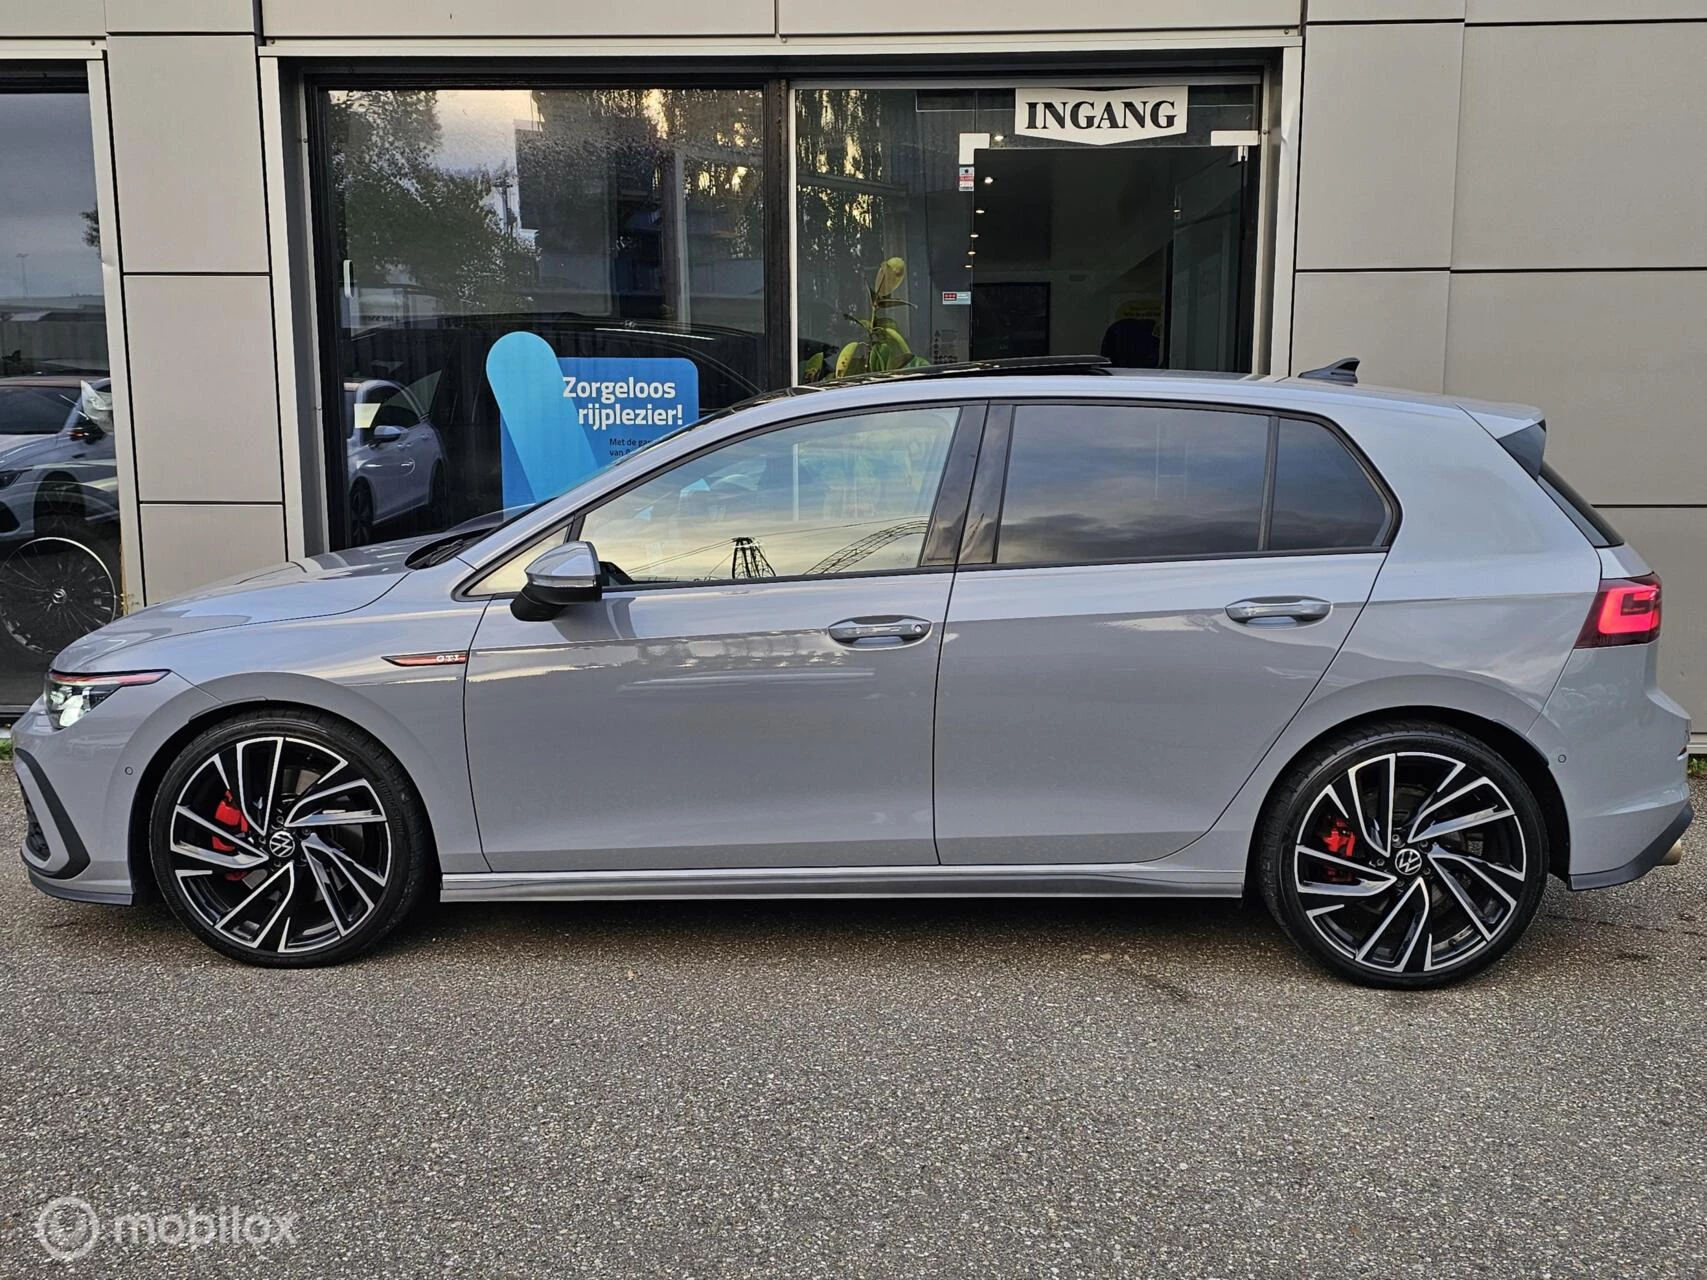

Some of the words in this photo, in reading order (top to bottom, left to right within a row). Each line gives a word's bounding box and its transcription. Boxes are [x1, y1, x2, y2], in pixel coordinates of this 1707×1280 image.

[1025, 100, 1177, 130] INGANG
[563, 376, 676, 404] Zorgeloos
[578, 404, 683, 430] rijplezier!
[609, 438, 625, 446] Met
